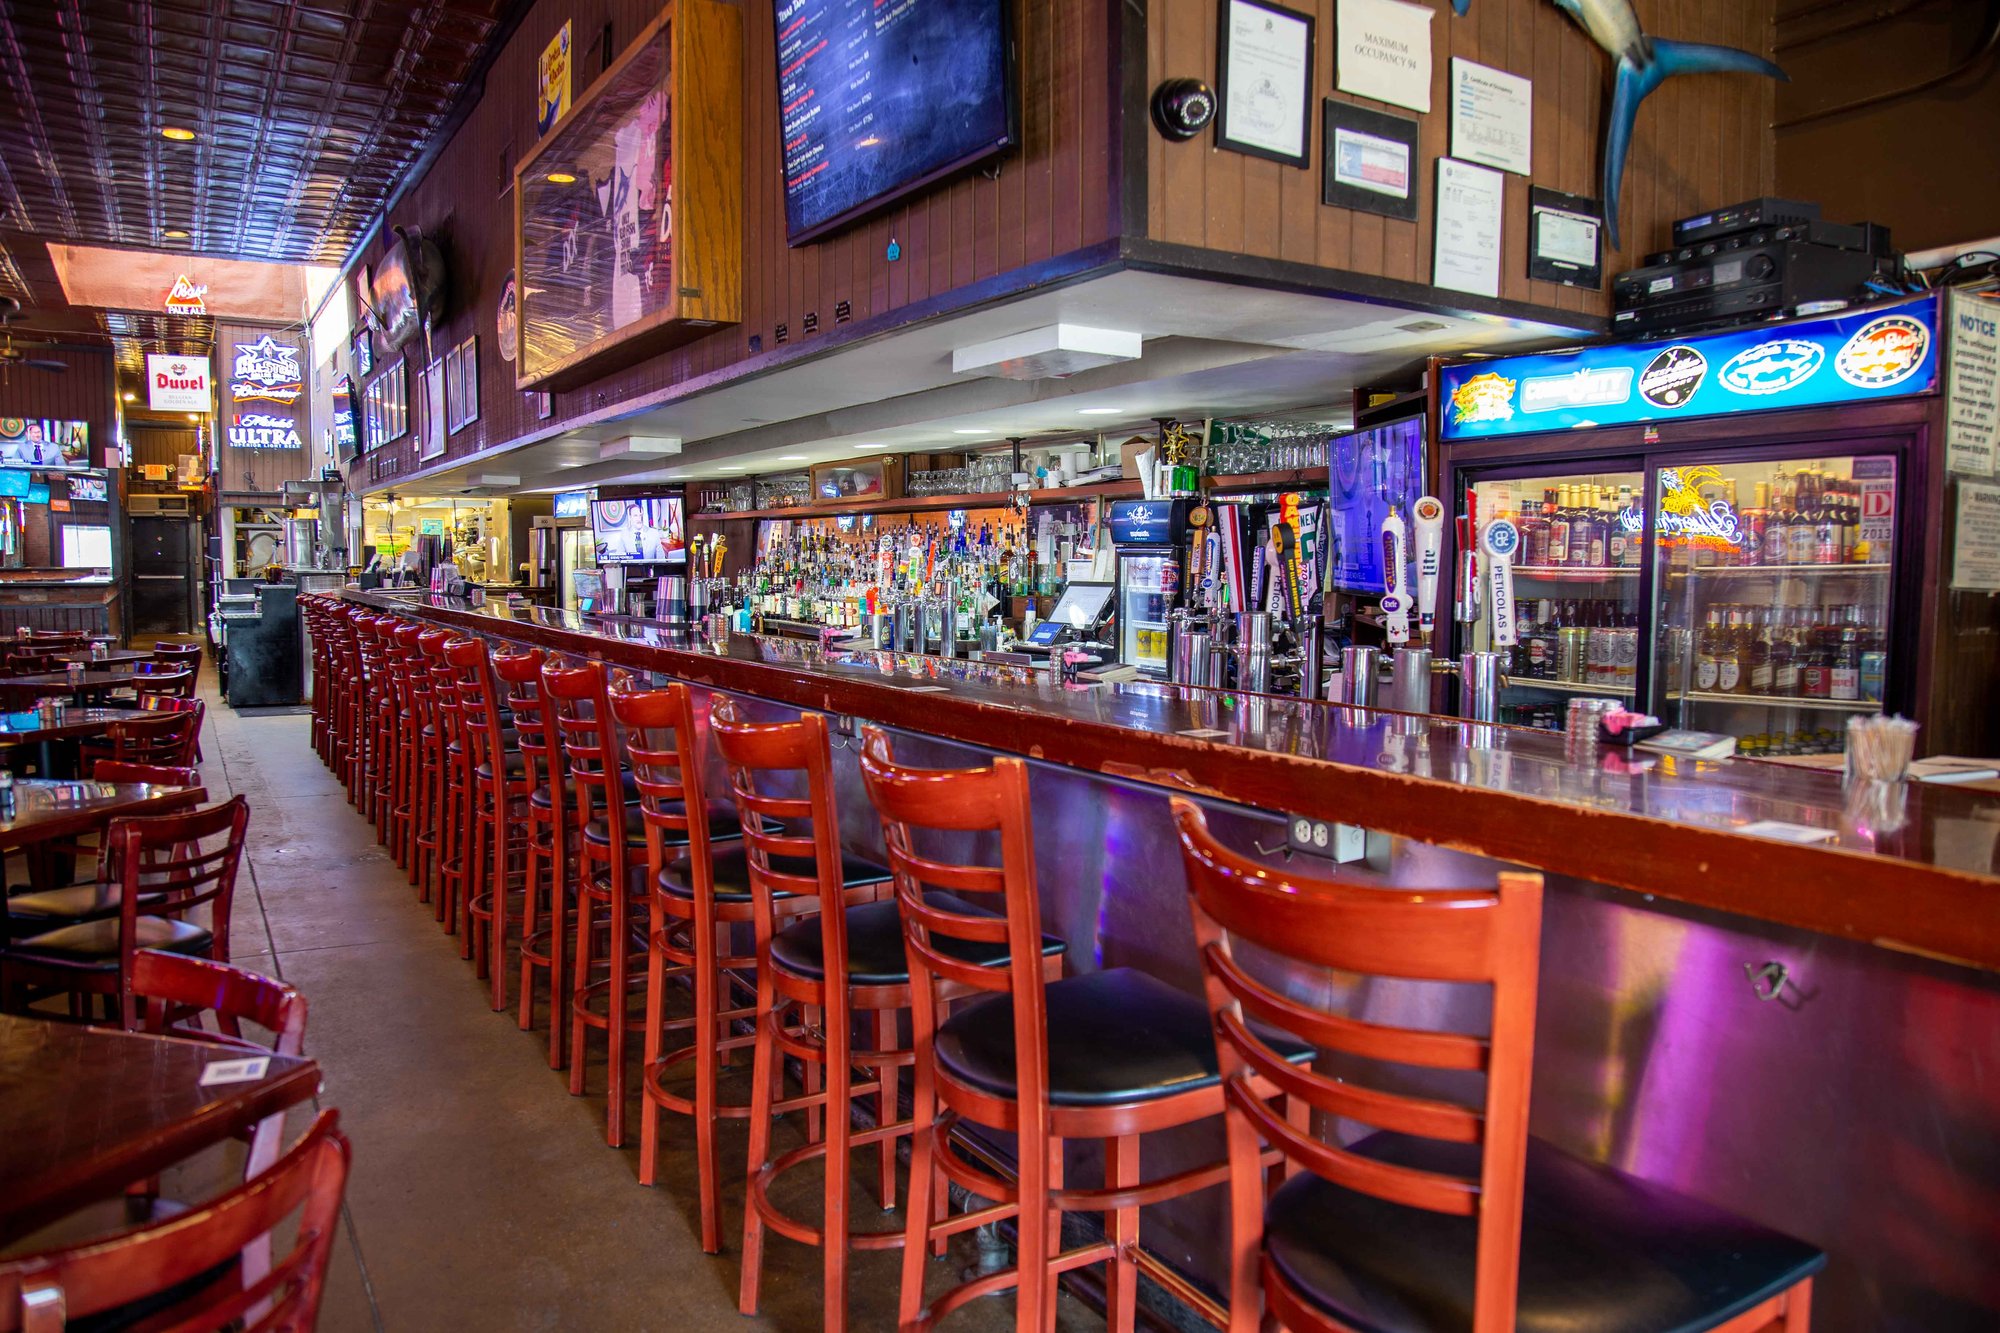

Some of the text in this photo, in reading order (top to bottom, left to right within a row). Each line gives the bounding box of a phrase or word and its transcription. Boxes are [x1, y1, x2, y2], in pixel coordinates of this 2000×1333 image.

[1364, 32, 1409, 54] MAXIMUM
[1354, 44, 1417, 70] OCCUPANCY 94
[168, 307, 207, 315] PALE ALE
[1960, 314, 1996, 336] NOTICE
[156, 373, 204, 390] Duvel
[229, 428, 302, 445] ULTRA
[1862, 529, 1892, 540] 2013
[1422, 550, 1437, 576] Lite
[1494, 565, 1508, 629] PETICOLAS
